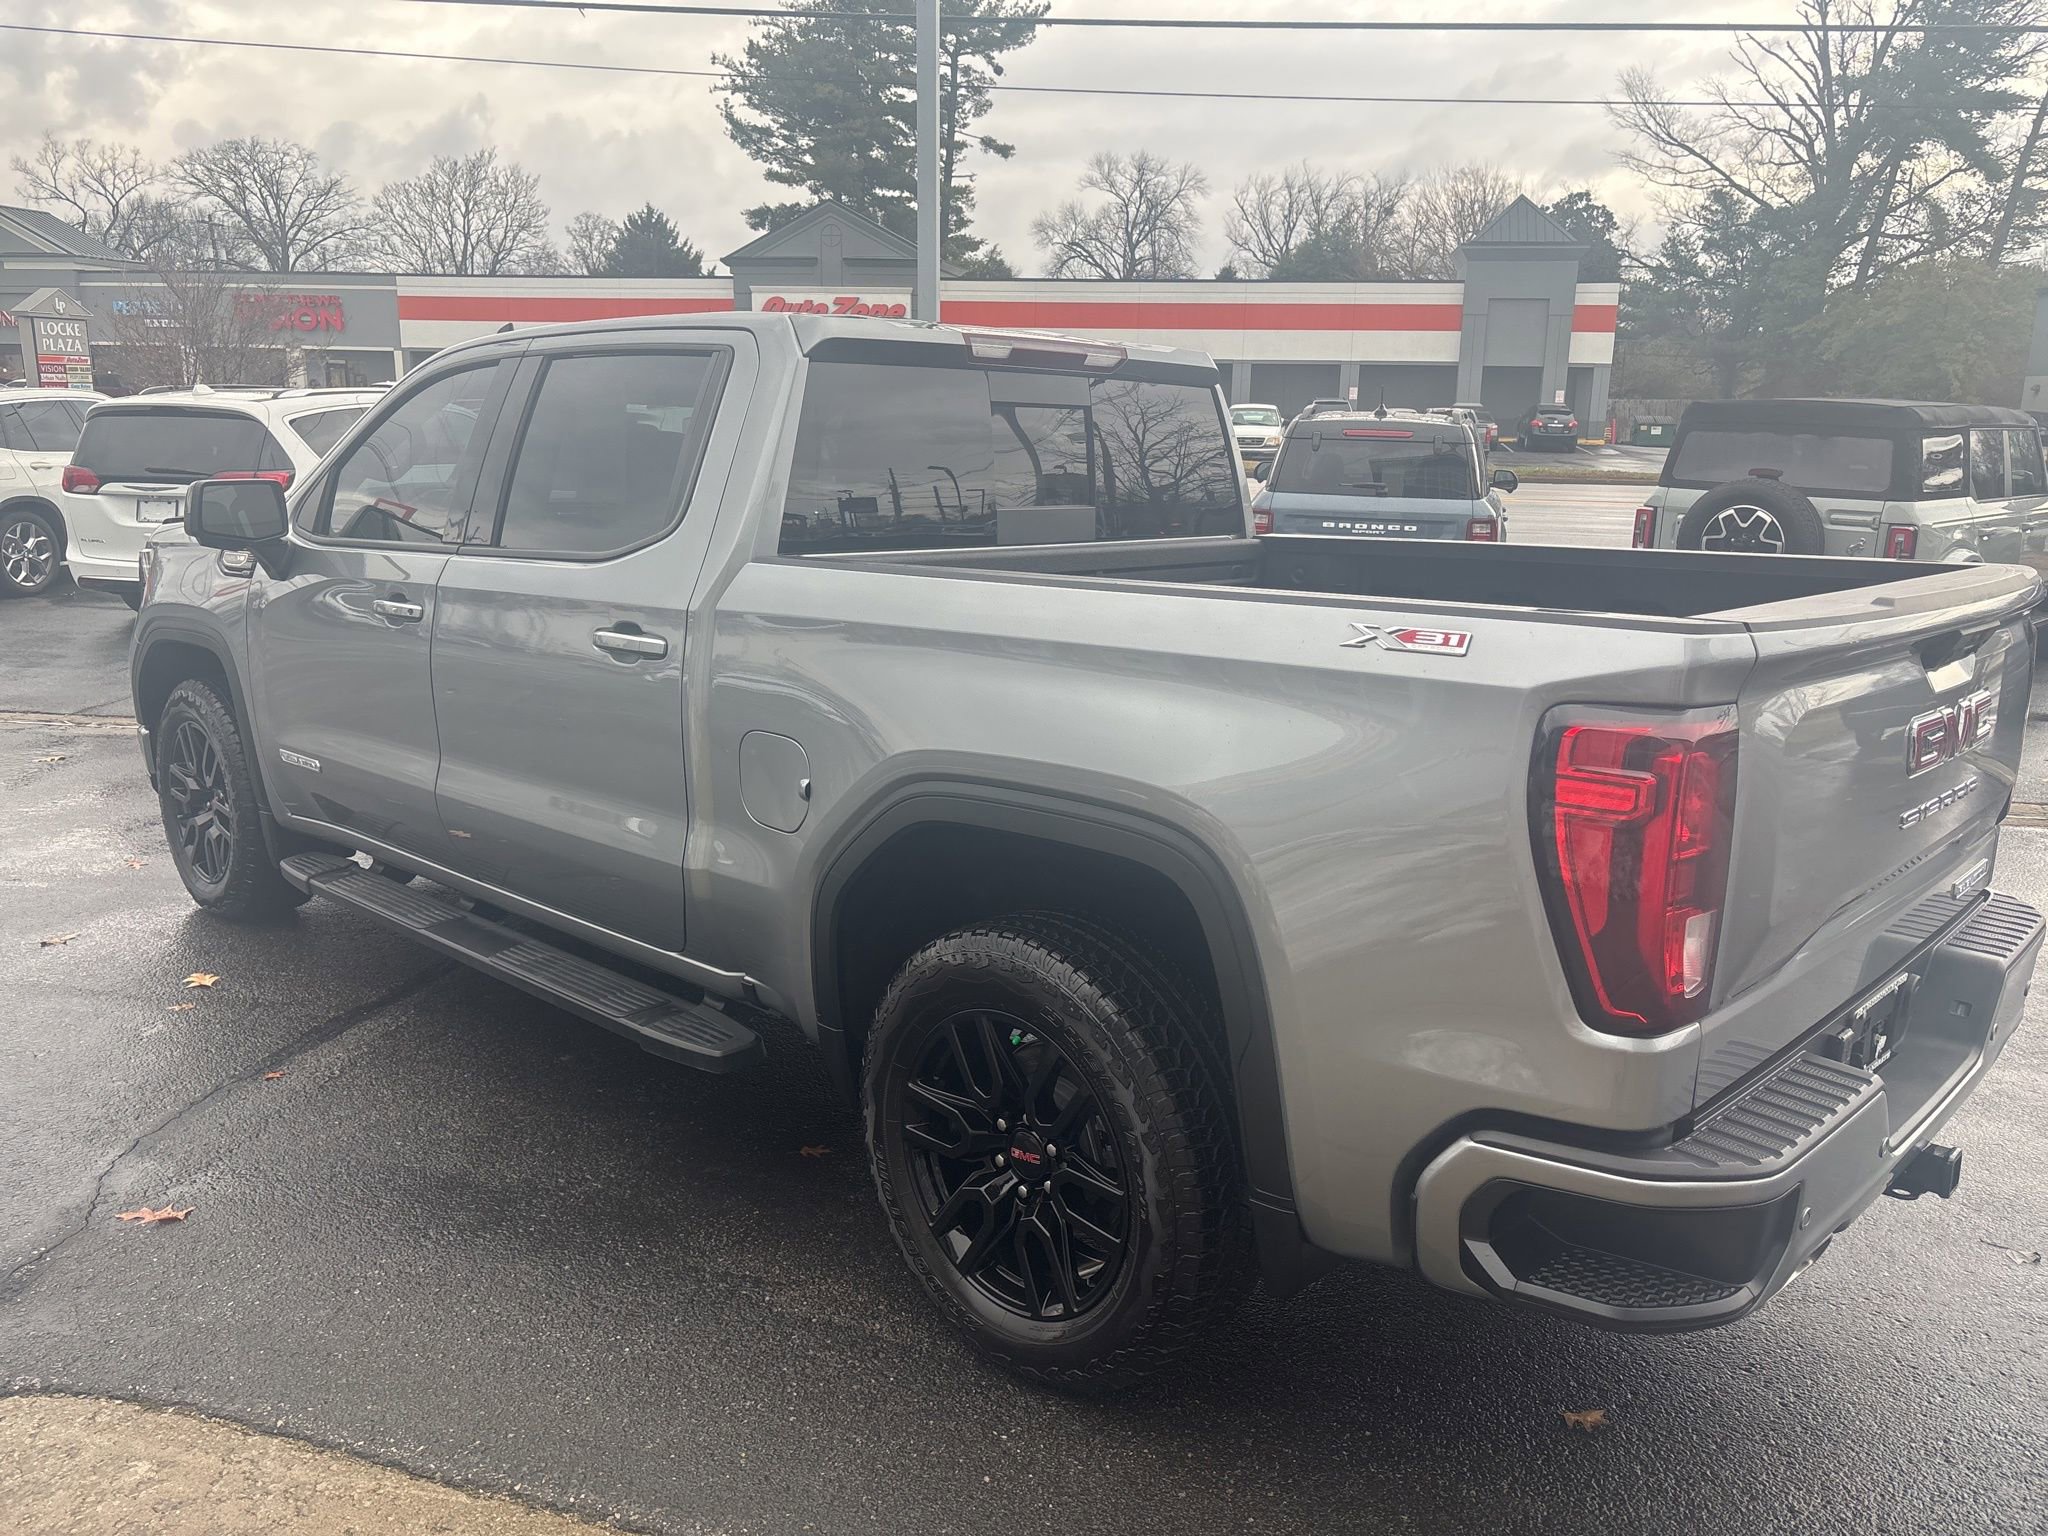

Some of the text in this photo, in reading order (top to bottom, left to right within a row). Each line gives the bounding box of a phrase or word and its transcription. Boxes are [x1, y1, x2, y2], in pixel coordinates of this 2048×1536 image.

[40, 321, 82, 336] LOCKE
[42, 338, 83, 352] PLAZA
[40, 365, 65, 373] VISION
[1322, 521, 1418, 532] BRONCO
[1339, 622, 1472, 656] X31
[1905, 687, 1993, 779] GMC
[1899, 776, 1978, 829] SIERRA
[1010, 1147, 1041, 1165] GMC
